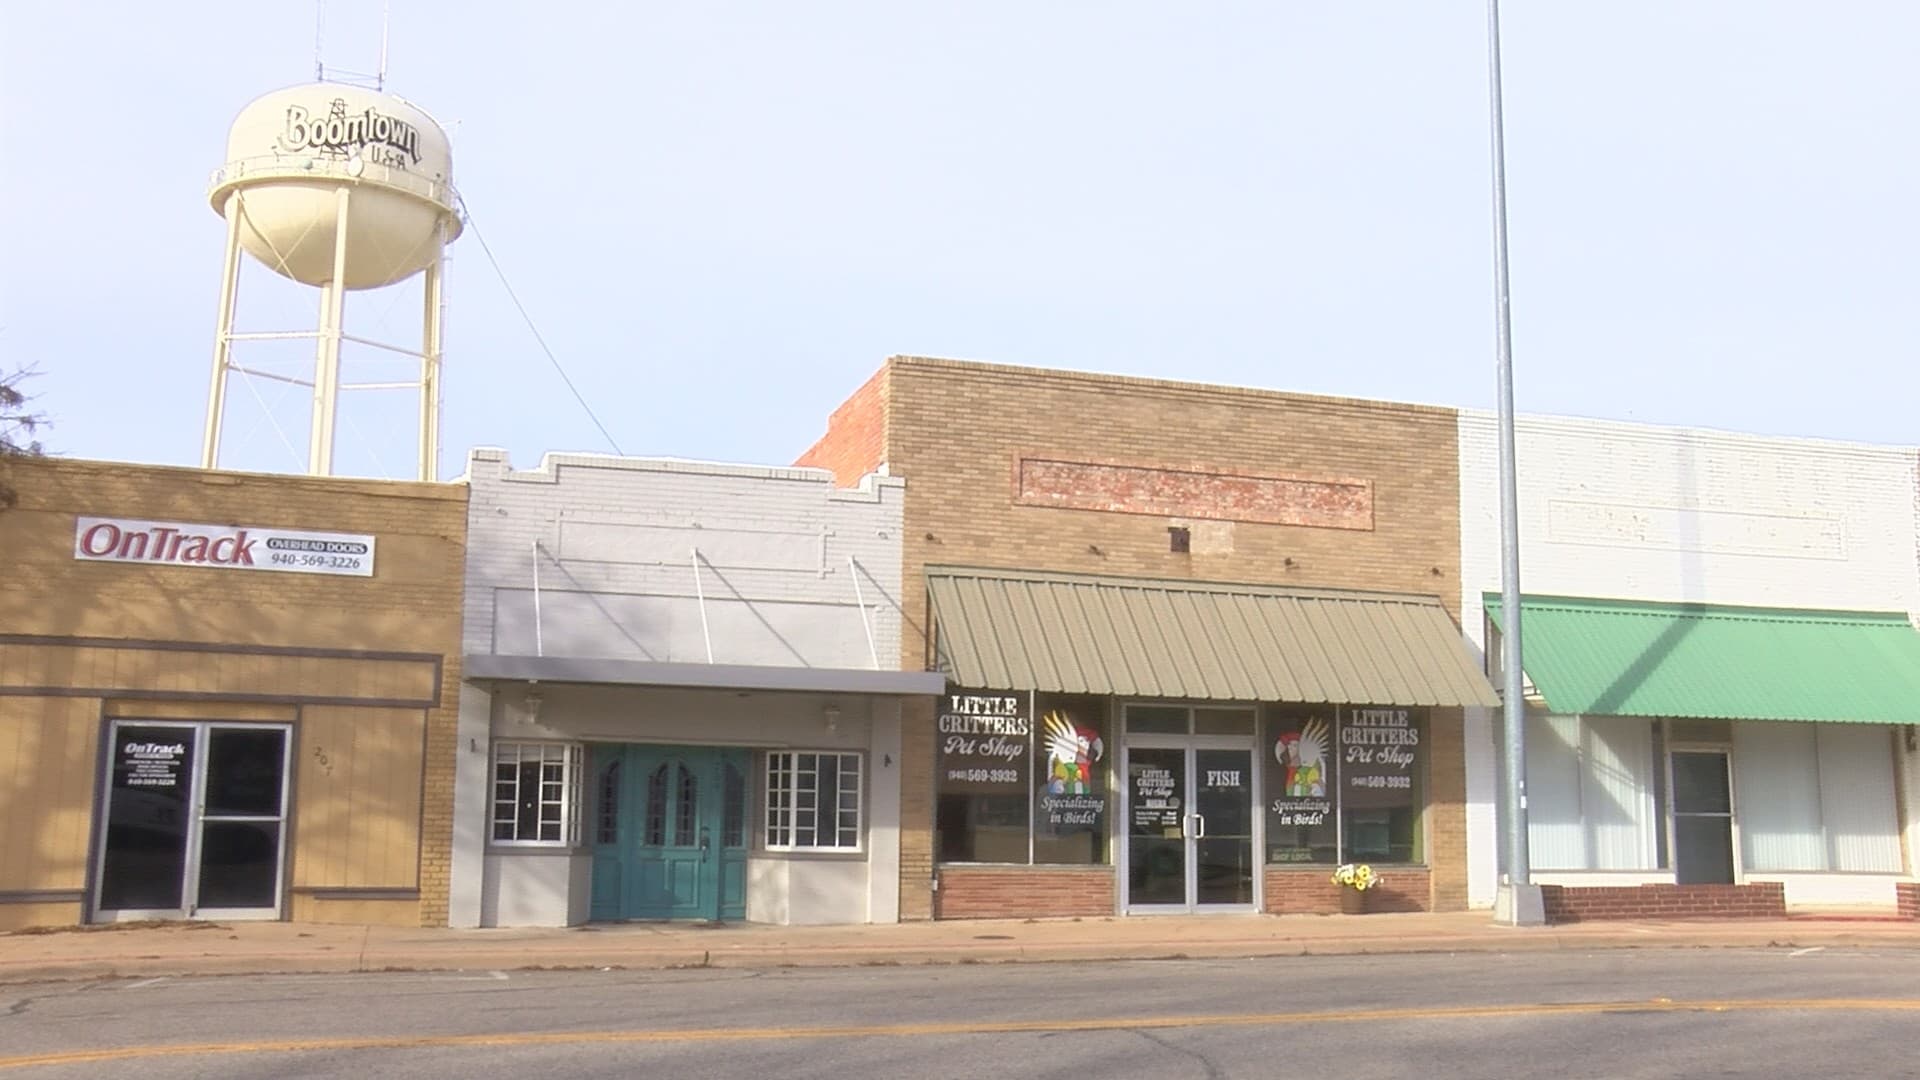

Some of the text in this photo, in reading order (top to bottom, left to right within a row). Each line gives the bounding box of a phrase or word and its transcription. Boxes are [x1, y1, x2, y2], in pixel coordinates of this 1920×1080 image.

[276, 104, 422, 165] Boomtown
[79, 523, 258, 566] OnTrack
[269, 539, 366, 555] OVERHEAD DOORS
[271, 553, 361, 569] 940-569-3226
[951, 695, 1017, 715] LITTLE
[939, 714, 1029, 736] CRITTERS
[1352, 709, 1408, 727] LITTLE
[1342, 728, 1419, 746] CRITTERS
[125, 743, 185, 754] OnTrack
[944, 735, 1024, 762] Pet Shop
[1345, 744, 1414, 768] Pet Shop
[968, 768, 1018, 783] 569-3932
[1207, 770, 1241, 787] FISH
[1041, 796, 1105, 812] Specializing
[1272, 799, 1331, 814] Specializing
[1050, 811, 1096, 825] in Birds!
[1281, 813, 1324, 826] in Birds!
